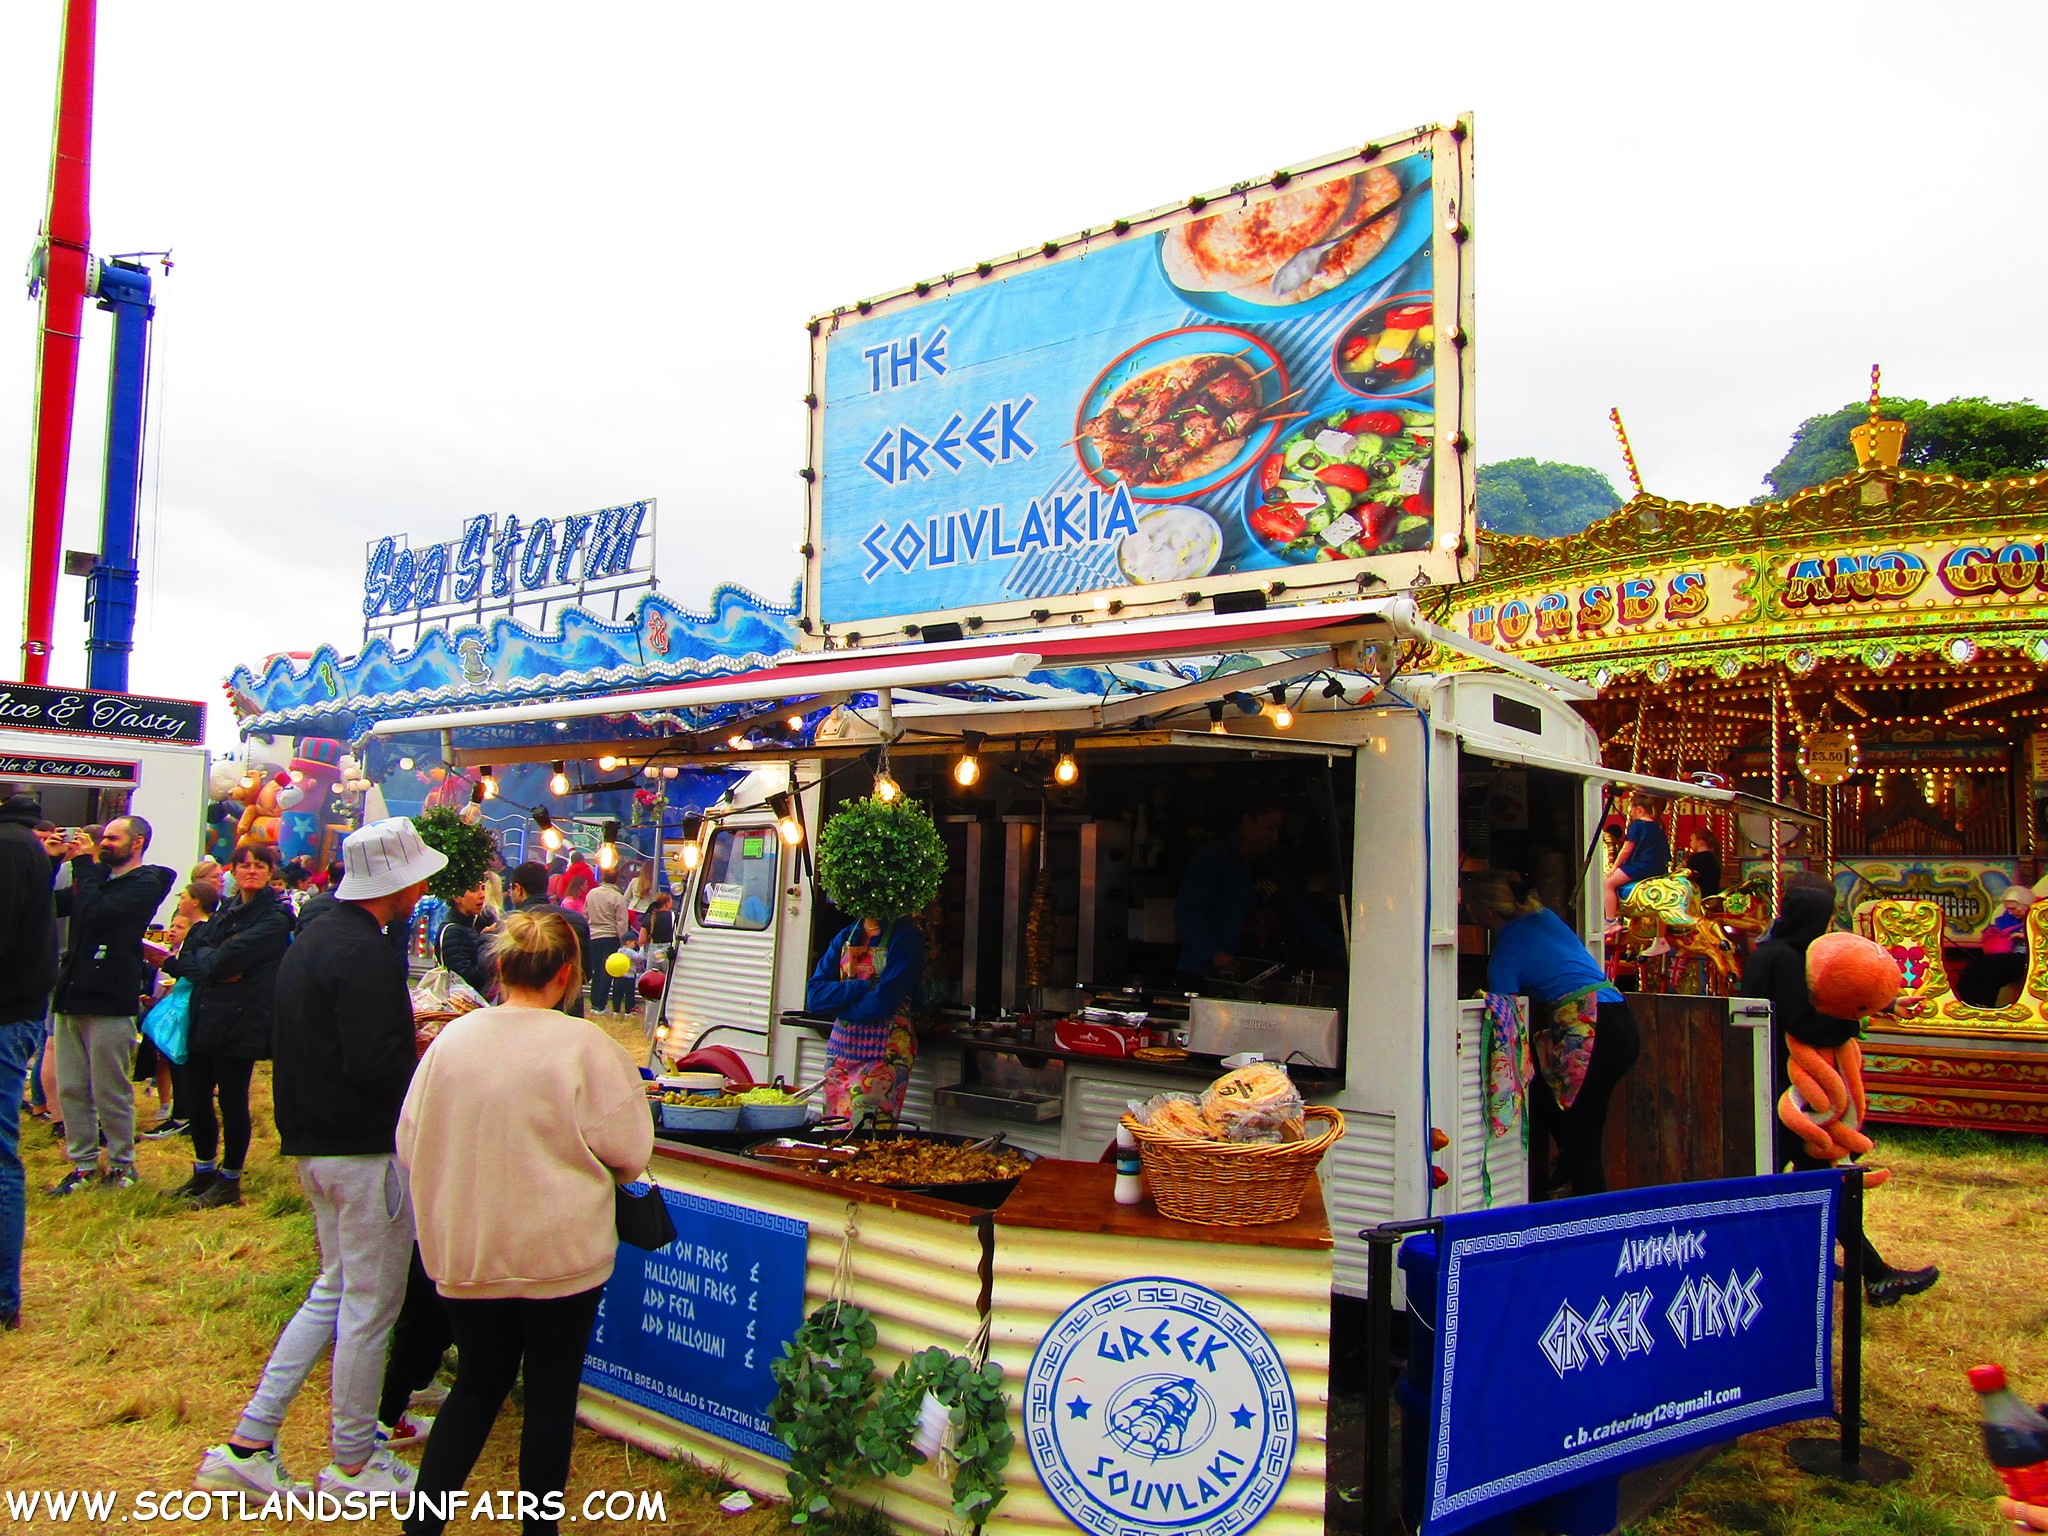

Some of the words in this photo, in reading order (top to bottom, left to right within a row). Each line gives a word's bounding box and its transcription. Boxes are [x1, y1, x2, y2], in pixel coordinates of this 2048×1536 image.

[863, 324, 951, 393] THE
[860, 393, 1039, 488] GREEK
[859, 480, 1141, 584] SOUVLAKIA
[1781, 550, 1931, 608] AND
[1936, 542, 2048, 597] GO
[1468, 572, 1709, 645] HORSES
[48, 696, 85, 726] &
[92, 698, 187, 738] Tasty
[22, 760, 38, 774] &
[40, 761, 73, 774] Cold
[74, 764, 122, 778] Drinks
[1811, 751, 1843, 762] £3.50
[675, 1240, 692, 1262] ON
[695, 1246, 729, 1273] FRIES
[750, 1262, 760, 1283] £
[1614, 1226, 1707, 1278] AUTHENTIC
[643, 1287, 666, 1308] ADD
[669, 1294, 695, 1321] FETA
[746, 1319, 756, 1340] £
[644, 1260, 700, 1294] HALLOUMI
[703, 1278, 738, 1306] FRIES
[748, 1291, 758, 1312] £
[641, 1313, 664, 1336] ADD
[667, 1322, 725, 1359] HALLOUMI
[744, 1348, 754, 1369] £
[1097, 1318, 1229, 1373] GREEK
[1537, 1286, 1655, 1380] GREEK
[1665, 1267, 1764, 1349] GYROS
[609, 1363, 633, 1382] PITTA
[635, 1373, 666, 1397] BREAD,
[666, 1385, 698, 1408] SALAD
[699, 1397, 705, 1410] &
[707, 1400, 752, 1428] TZATZIKI
[754, 1417, 777, 1438] SAL
[1562, 1384, 1742, 1451] c.b.catering12@gmail.com
[1087, 1449, 1245, 1513] SOUVLAKI
